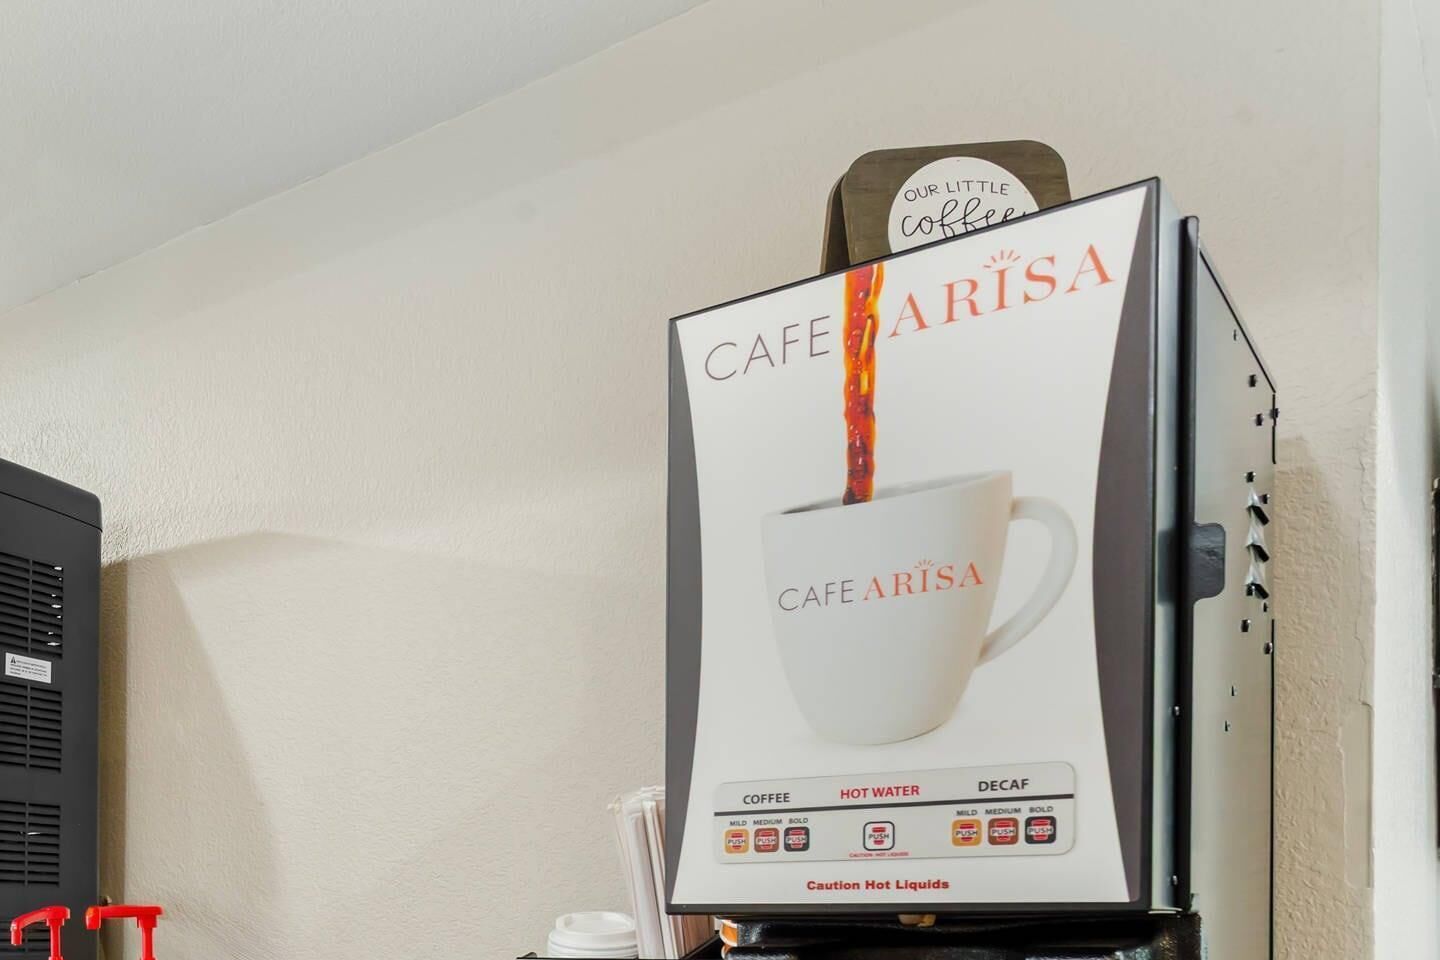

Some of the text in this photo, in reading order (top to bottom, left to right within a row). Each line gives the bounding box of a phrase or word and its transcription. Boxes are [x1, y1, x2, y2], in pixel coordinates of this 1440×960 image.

[904, 180, 1010, 202] OUR LITTLE
[705, 244, 1116, 381] CAFE ARISA
[778, 560, 983, 611] CAFE ARISA
[840, 785, 920, 799] HOT WATER
[978, 778, 1029, 792] DECAF
[743, 793, 790, 805] COFFEE
[985, 807, 1021, 815] MEDIUM
[807, 879, 949, 891] Caution Hot Liquids
